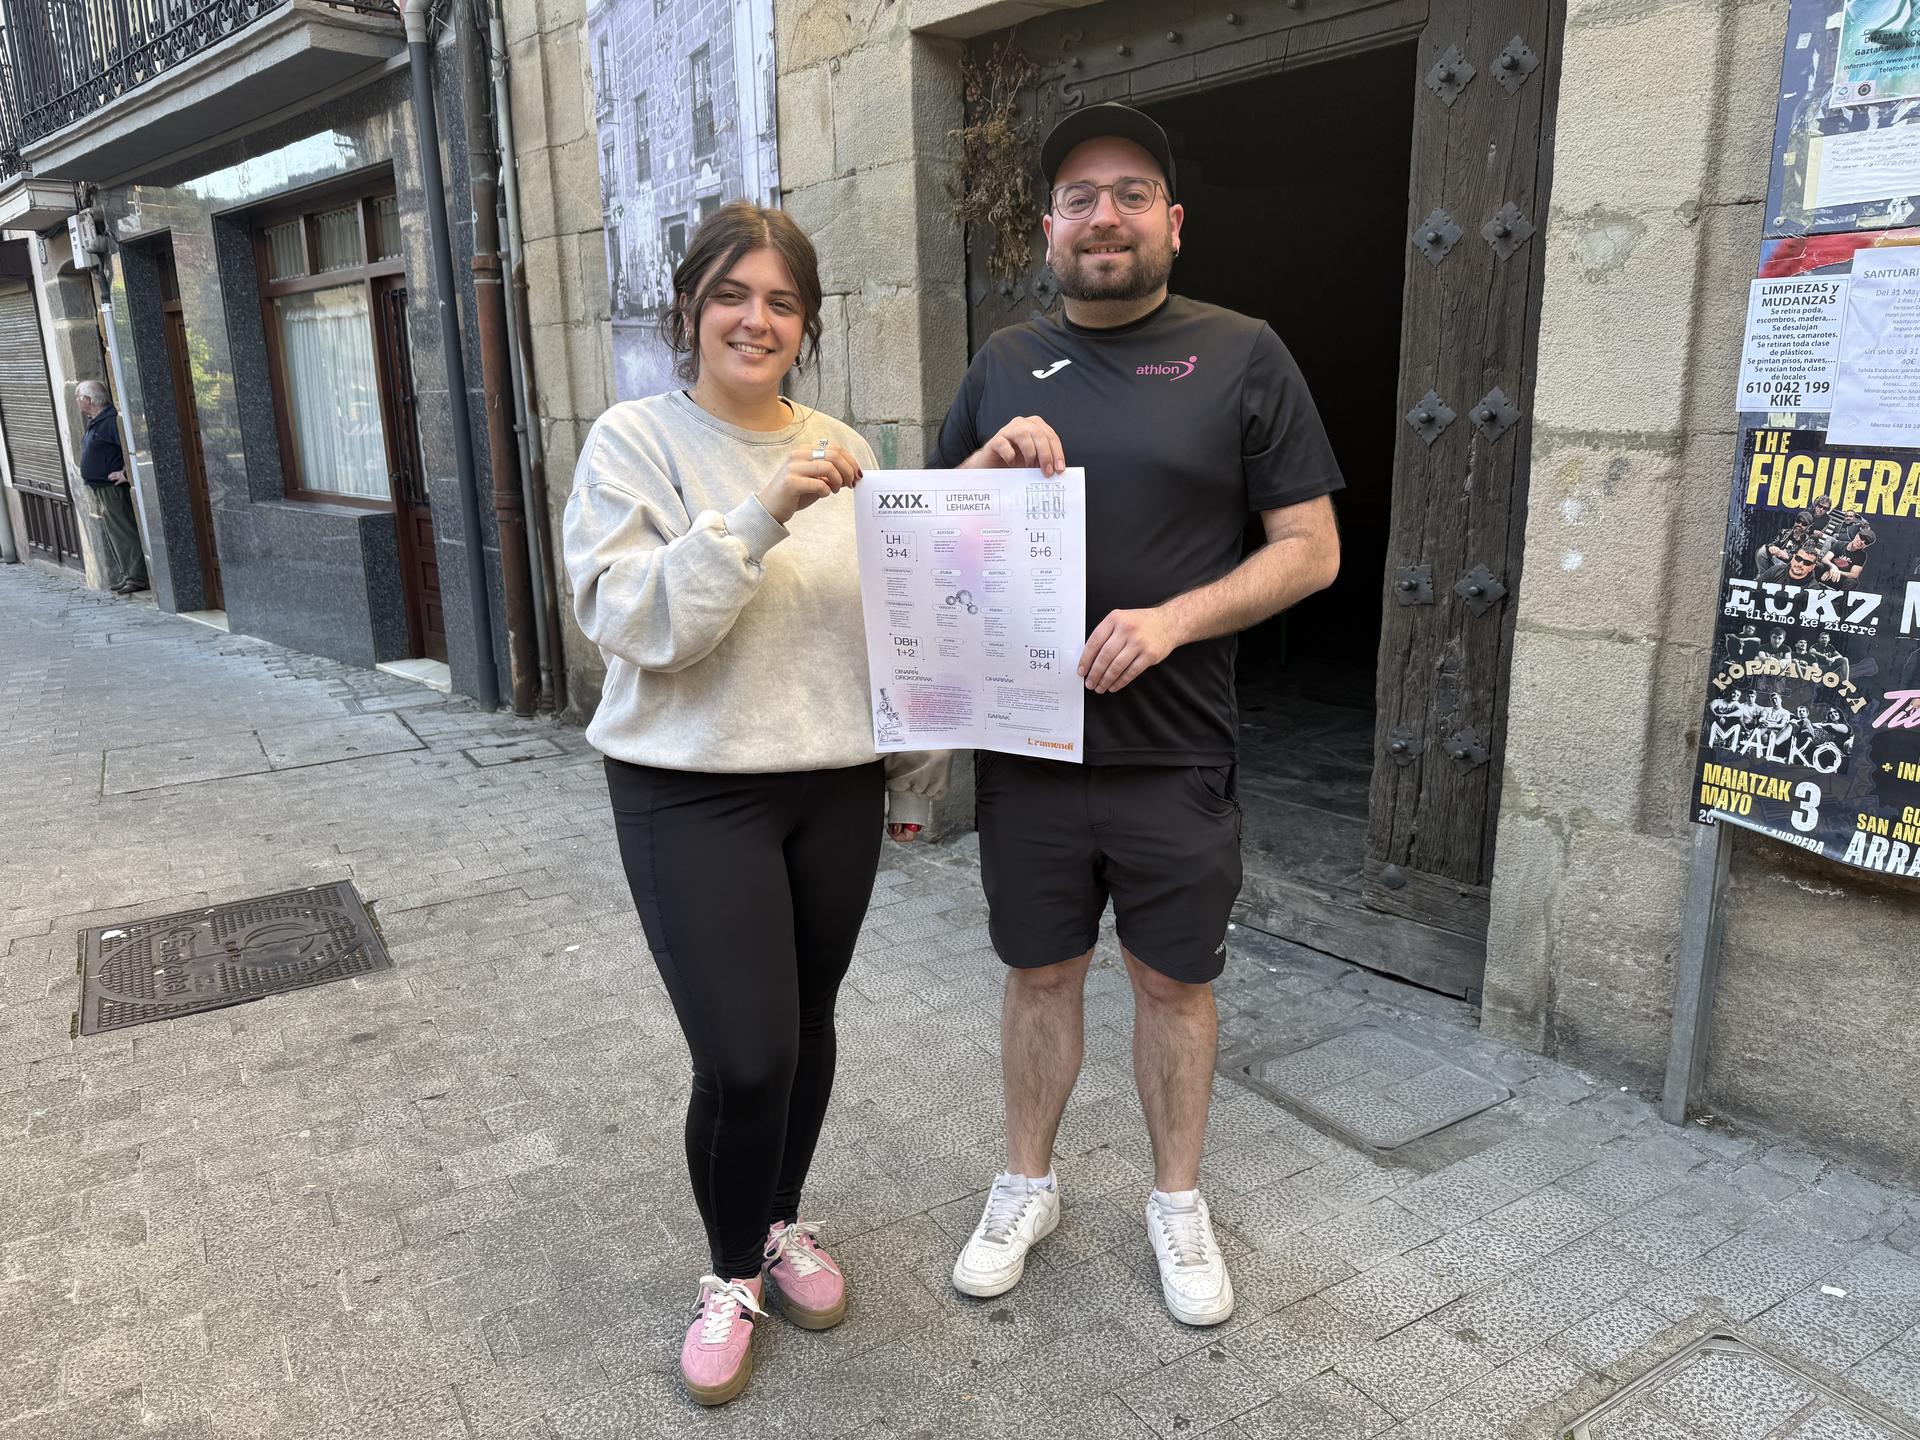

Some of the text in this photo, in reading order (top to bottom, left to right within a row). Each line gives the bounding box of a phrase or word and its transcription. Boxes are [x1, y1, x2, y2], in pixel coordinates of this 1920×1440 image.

[1864, 268, 1920, 278] SANTUARI
[1762, 283, 1840, 295] LIMPIEZAS y
[1762, 295, 1836, 307] MUDANZAS
[1802, 306, 1823, 315] poda,
[1751, 333, 1771, 341] pisos,
[1780, 349, 1814, 357] plásticos.
[1757, 358, 1780, 366] pintan
[1136, 365, 1180, 375] athlon
[1746, 382, 1830, 393] 610 042 199
[1770, 394, 1802, 406] KIKE
[1755, 431, 1792, 453] THE
[878, 494, 929, 509] XXIX.
[886, 534, 901, 544] LH
[1030, 532, 1045, 542] LH
[886, 547, 908, 558] 3+4
[1030, 546, 1051, 558] 5+6
[1724, 606, 1877, 636] el último ke zierre
[894, 637, 918, 646] DBH
[896, 648, 915, 658] 1+2
[1030, 649, 1055, 659] DBH
[1030, 661, 1050, 670] 3+4
[1709, 721, 1842, 773] MALKO
[1702, 762, 1793, 802] MAIATZAK
[1700, 784, 1752, 816] MAYO
[1790, 782, 1821, 832] 3
[1857, 813, 1889, 836] SAN
